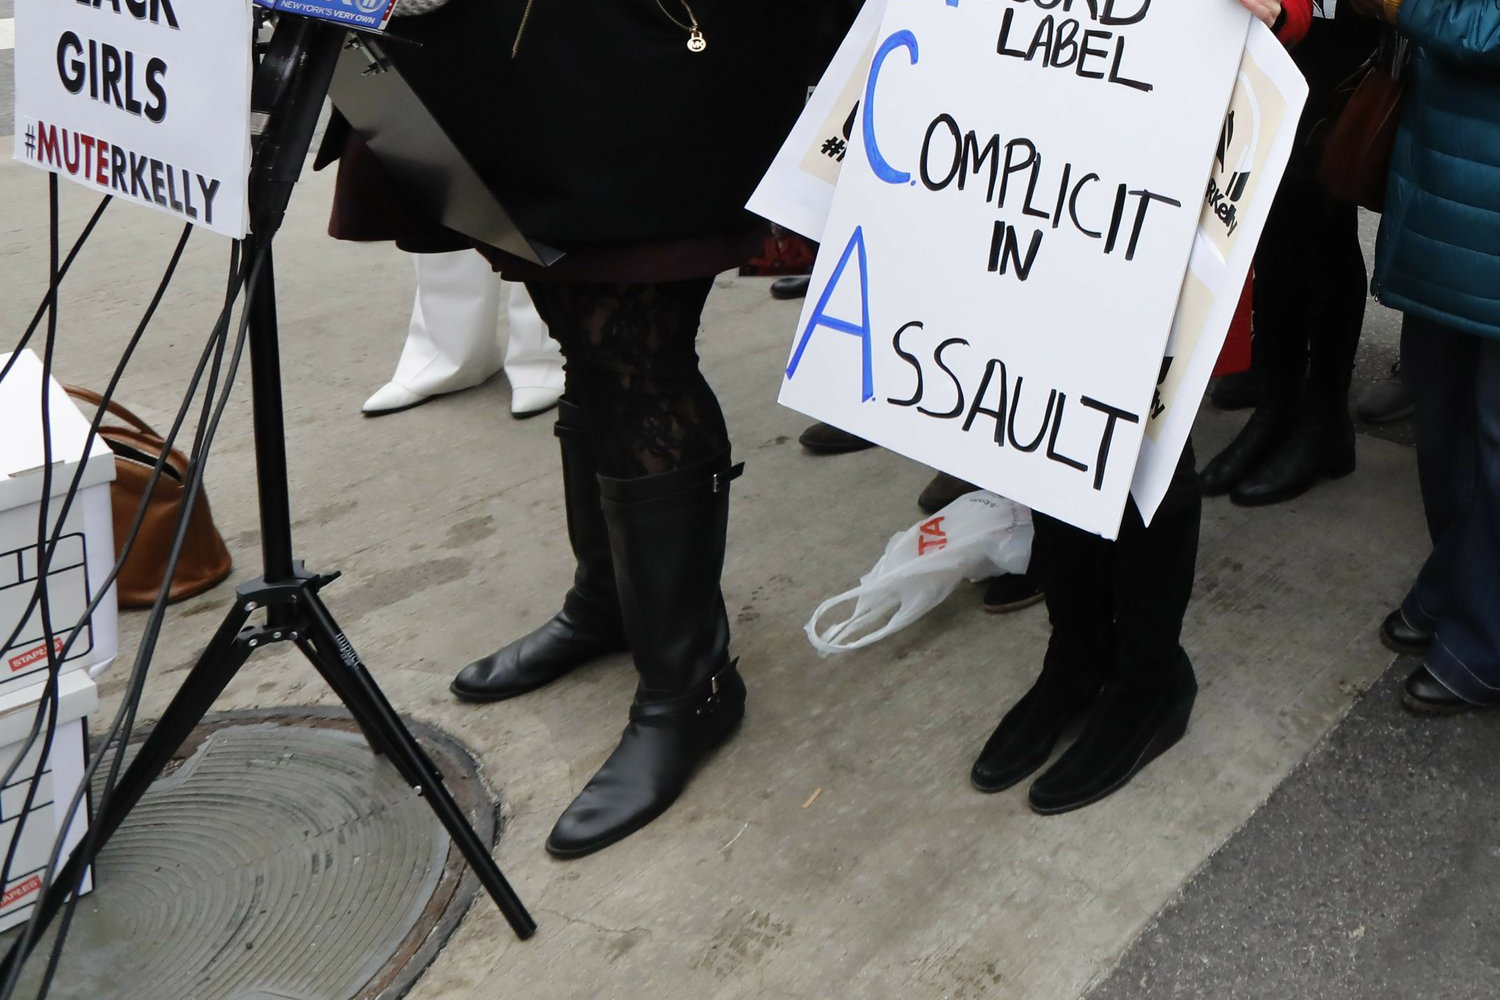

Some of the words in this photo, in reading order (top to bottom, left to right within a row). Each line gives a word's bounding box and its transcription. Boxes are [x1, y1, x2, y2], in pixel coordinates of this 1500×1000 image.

[333, 10, 356, 20] VERY
[356, 14, 376, 25] OWN
[997, 8, 1153, 92] LABEL
[56, 31, 169, 123] GIRLS
[24, 120, 221, 225] #MUTERKELLY
[862, 28, 1180, 261] COMPLICIT
[987, 219, 1042, 281] IN
[785, 225, 1139, 491] ASSAULT
